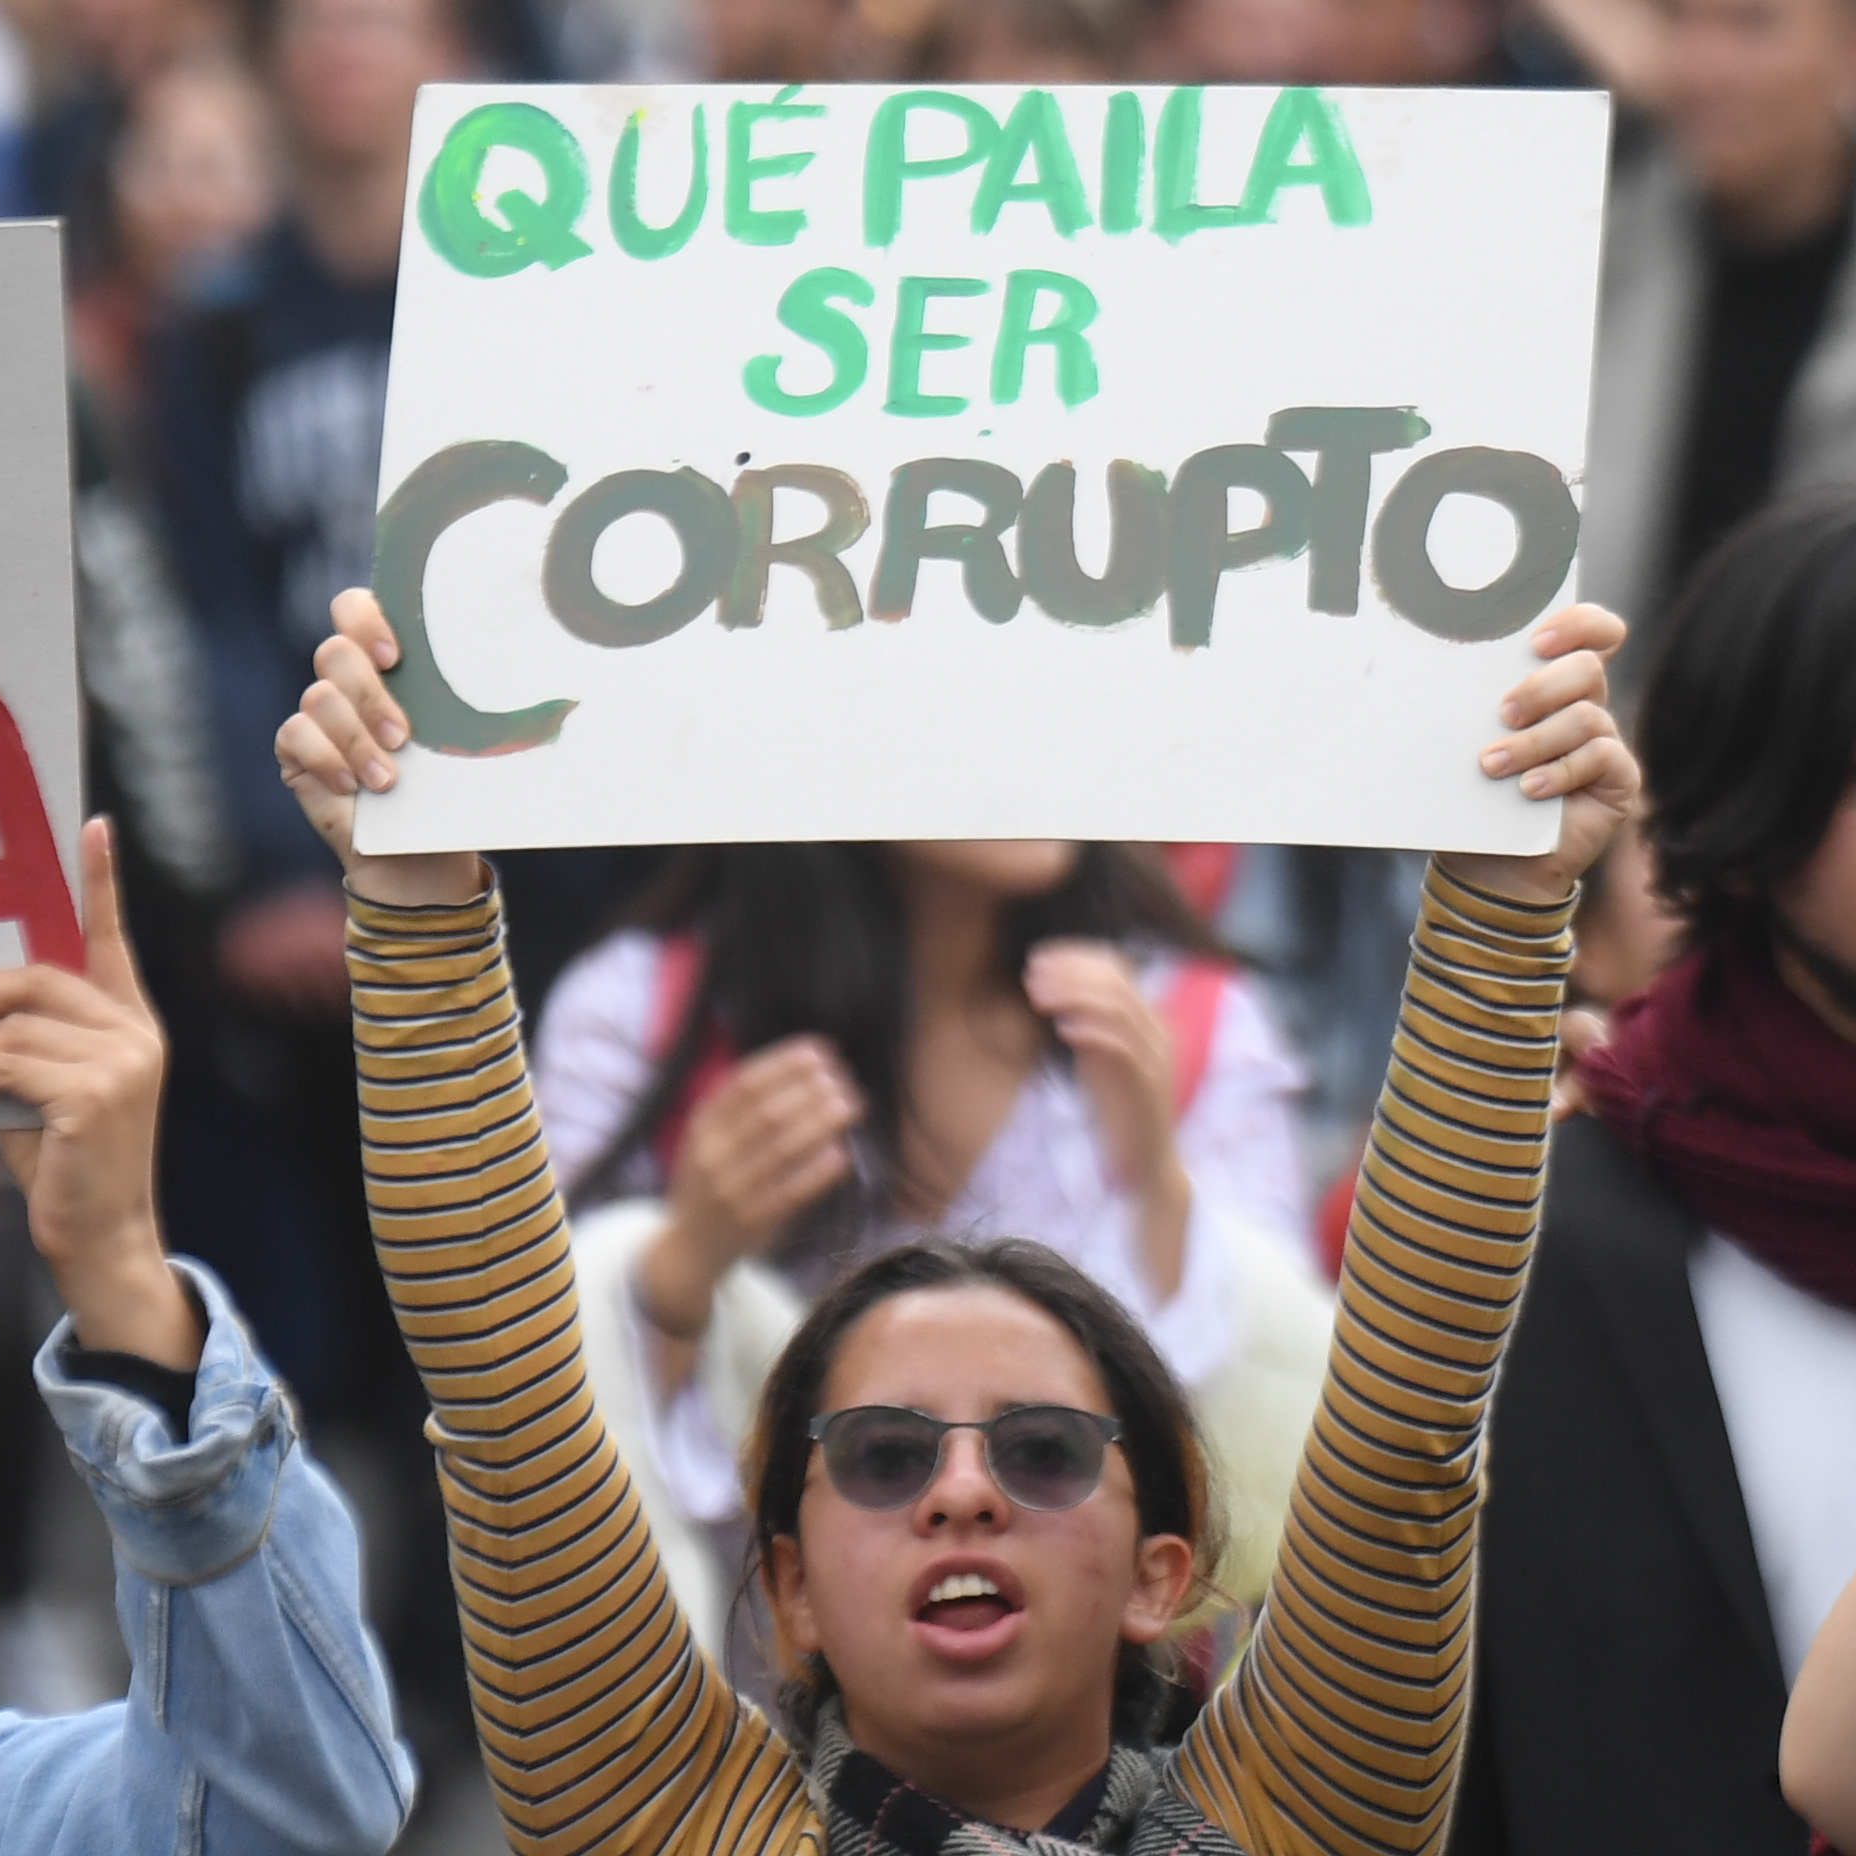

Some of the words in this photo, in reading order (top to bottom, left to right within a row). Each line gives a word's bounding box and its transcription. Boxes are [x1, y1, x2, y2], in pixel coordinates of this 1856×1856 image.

[417, 86, 828, 277] QUÉ
[862, 86, 1373, 248] PAILA
[742, 267, 1100, 418] SER
[370, 405, 1581, 757] CORRUPTO
